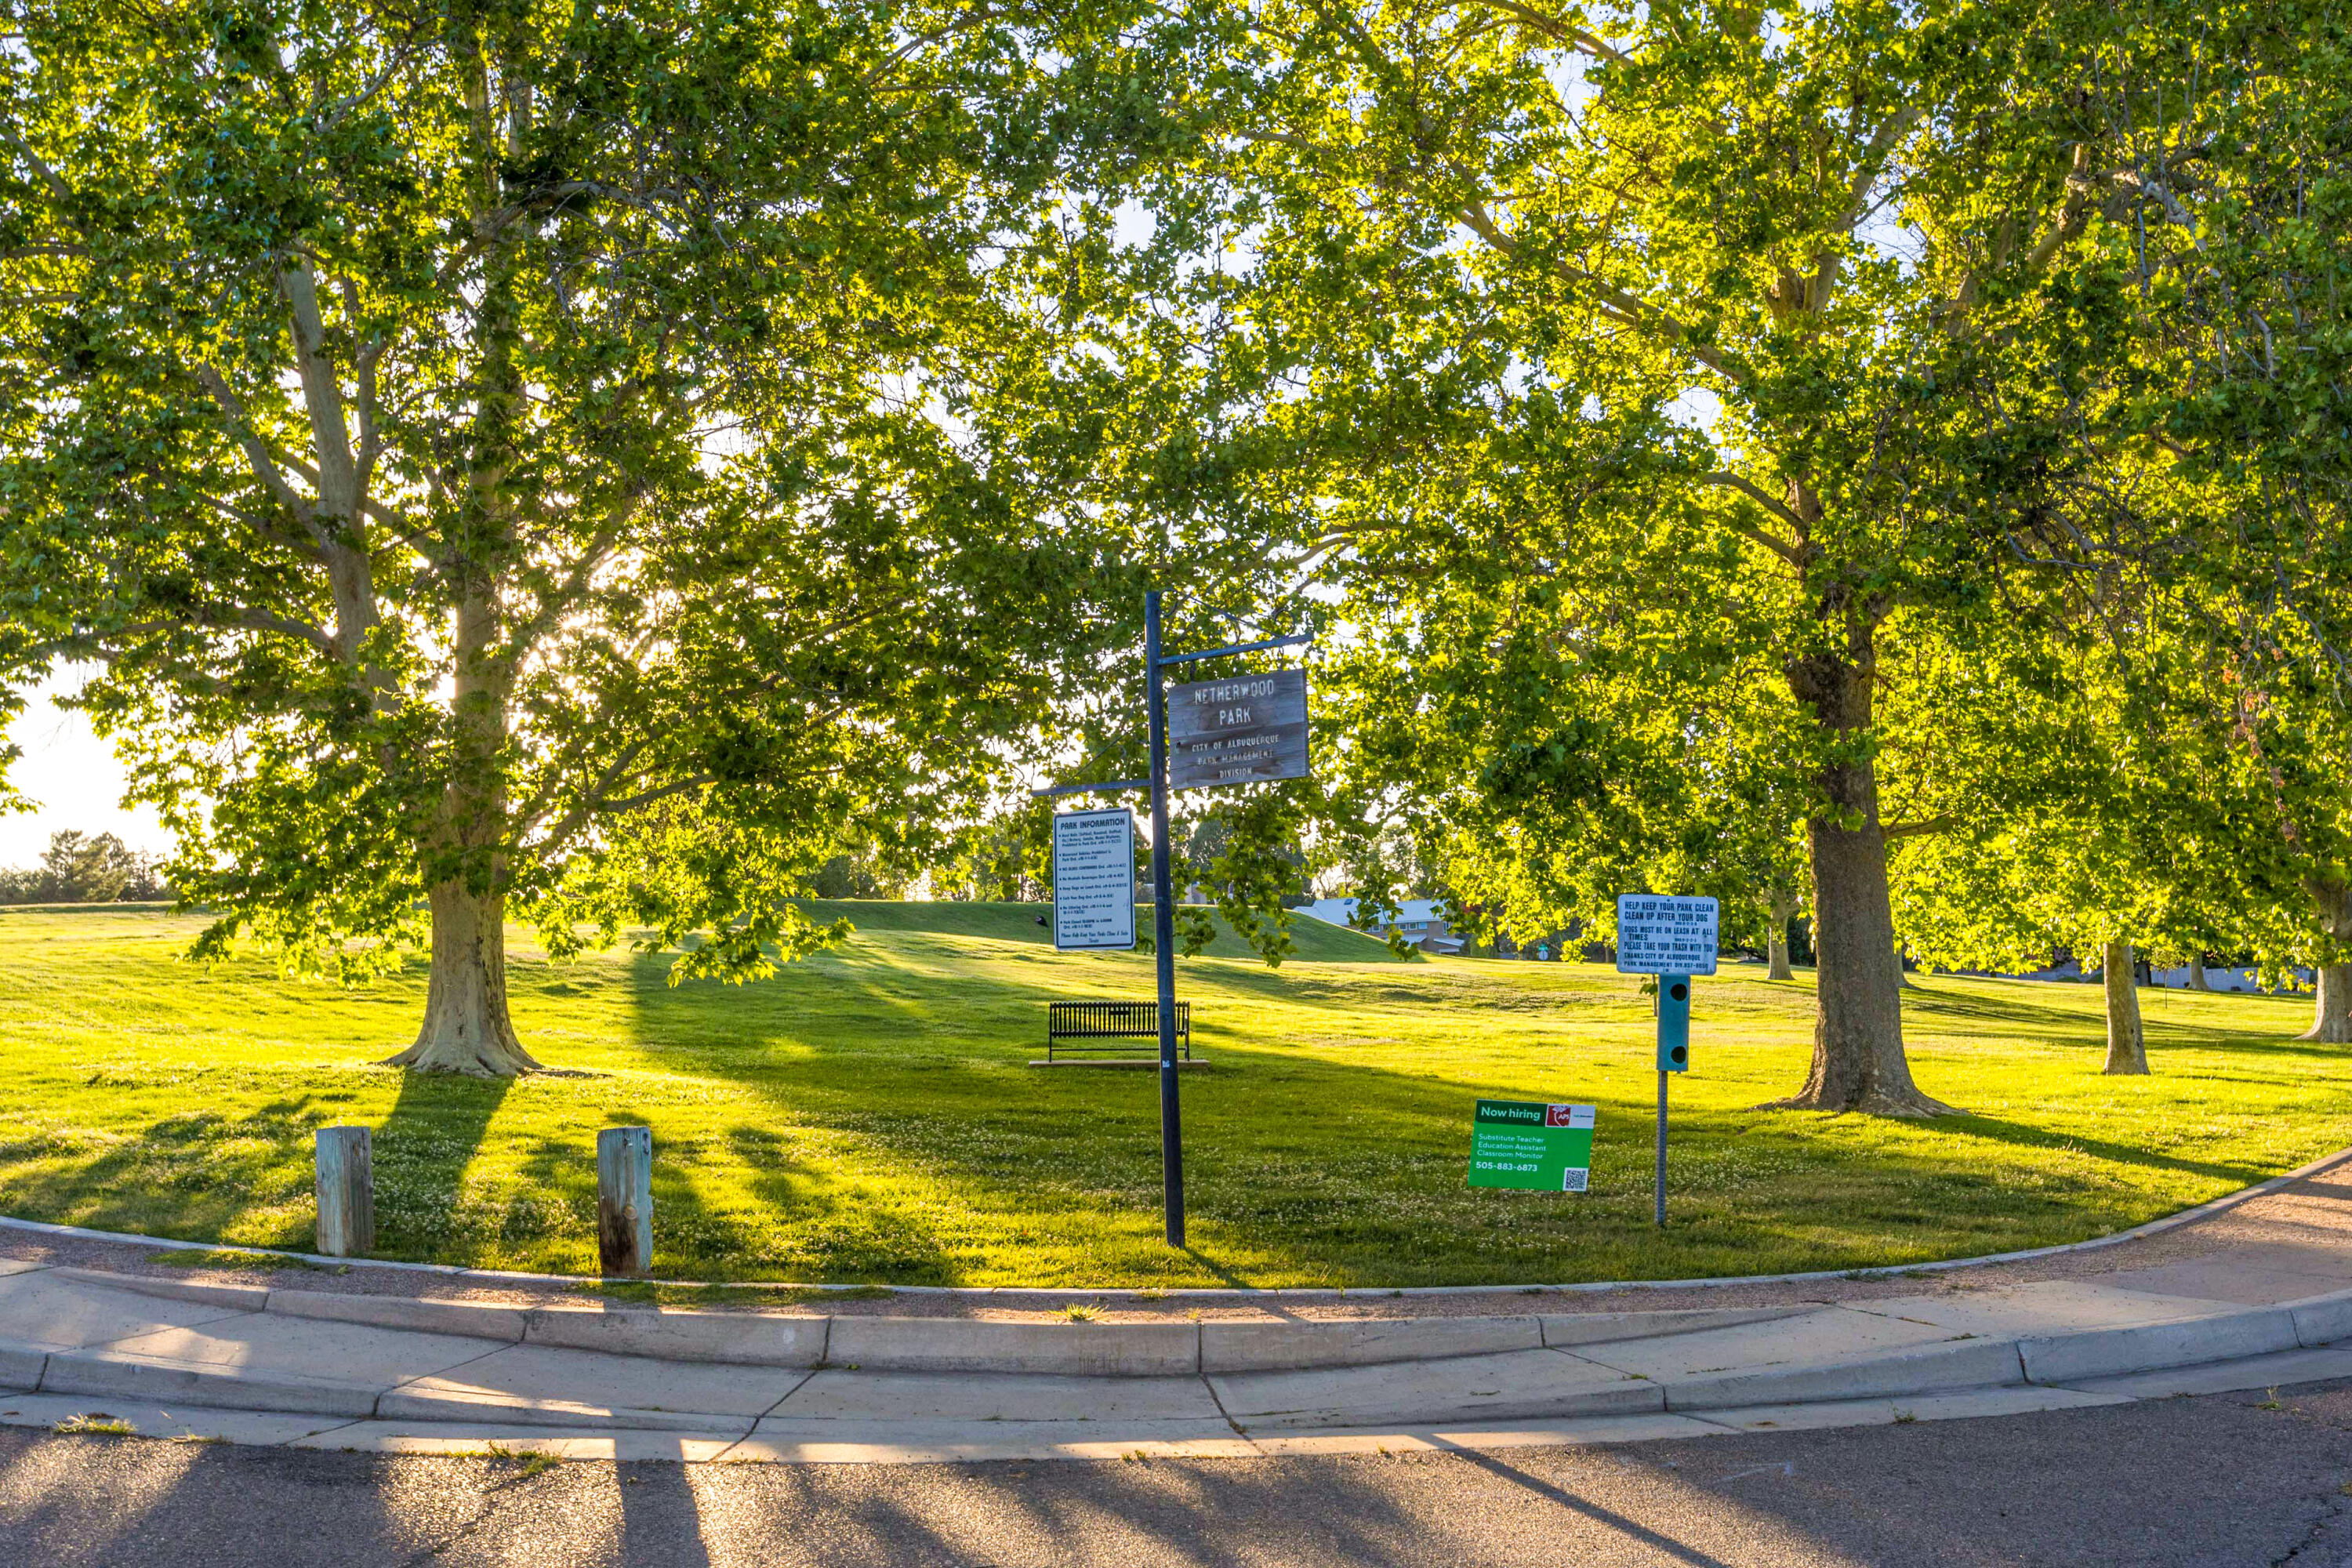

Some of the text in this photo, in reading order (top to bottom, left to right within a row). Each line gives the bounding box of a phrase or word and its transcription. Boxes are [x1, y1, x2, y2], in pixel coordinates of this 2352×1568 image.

[1195, 679, 1274, 705] NETHERWOOD
[1219, 707, 1251, 725] PARK
[1228, 735, 1279, 749] ALBUQUERQUE
[1222, 750, 1273, 763] MANAGEMENT
[1220, 767, 1252, 779] DIVISION
[1061, 818, 1125, 830] PARK INFORMATION
[1677, 903, 1692, 912] PARK
[1697, 913, 1708, 922] DOG
[1658, 942, 1670, 951] YOUR
[1481, 1106, 1541, 1121] Now hiring
[1475, 1162, 1537, 1171] 505-883-6873
